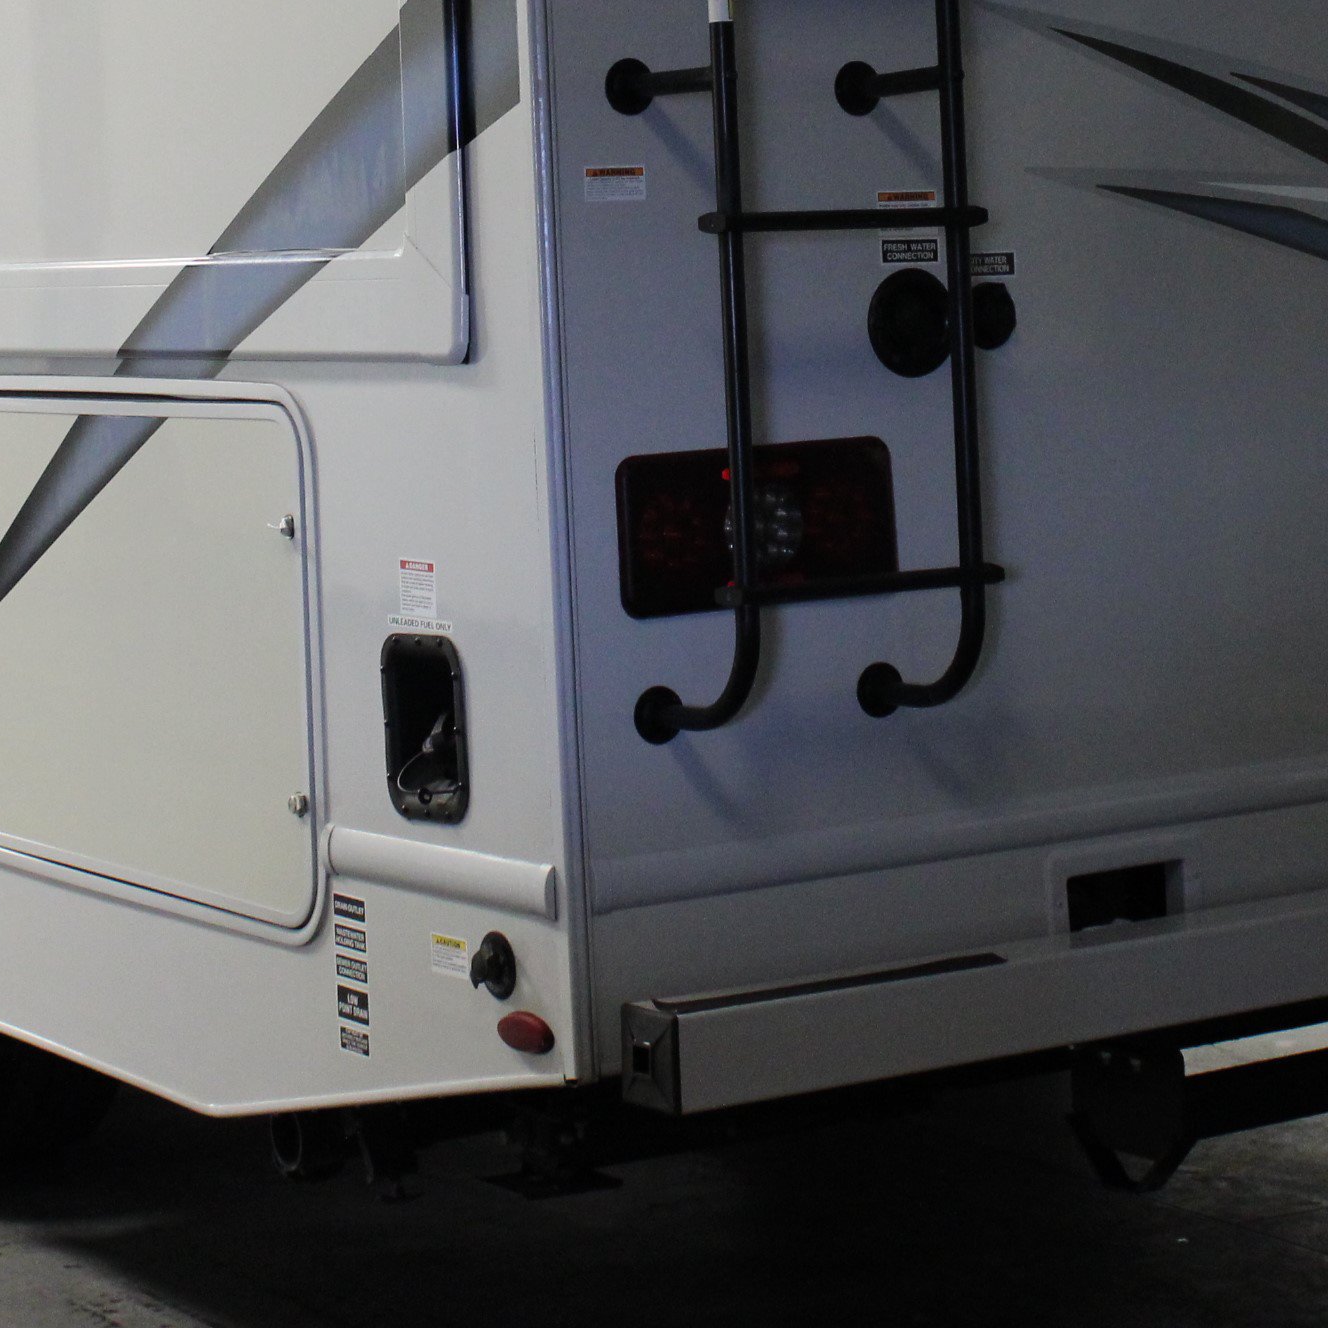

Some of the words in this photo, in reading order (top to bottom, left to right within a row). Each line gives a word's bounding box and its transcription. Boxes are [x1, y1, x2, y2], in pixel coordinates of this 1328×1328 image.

[599, 168, 636, 176] WARNING
[892, 192, 929, 201] WARNING
[883, 243, 908, 251] FRESH
[910, 242, 936, 251] WATER
[886, 252, 934, 260] CONNECTION
[984, 255, 1007, 264] WATER
[970, 265, 1009, 273] ONNECTION
[389, 617, 419, 627] UNLEADED
[420, 620, 434, 630] FUEL
[435, 622, 451, 632] ONLY
